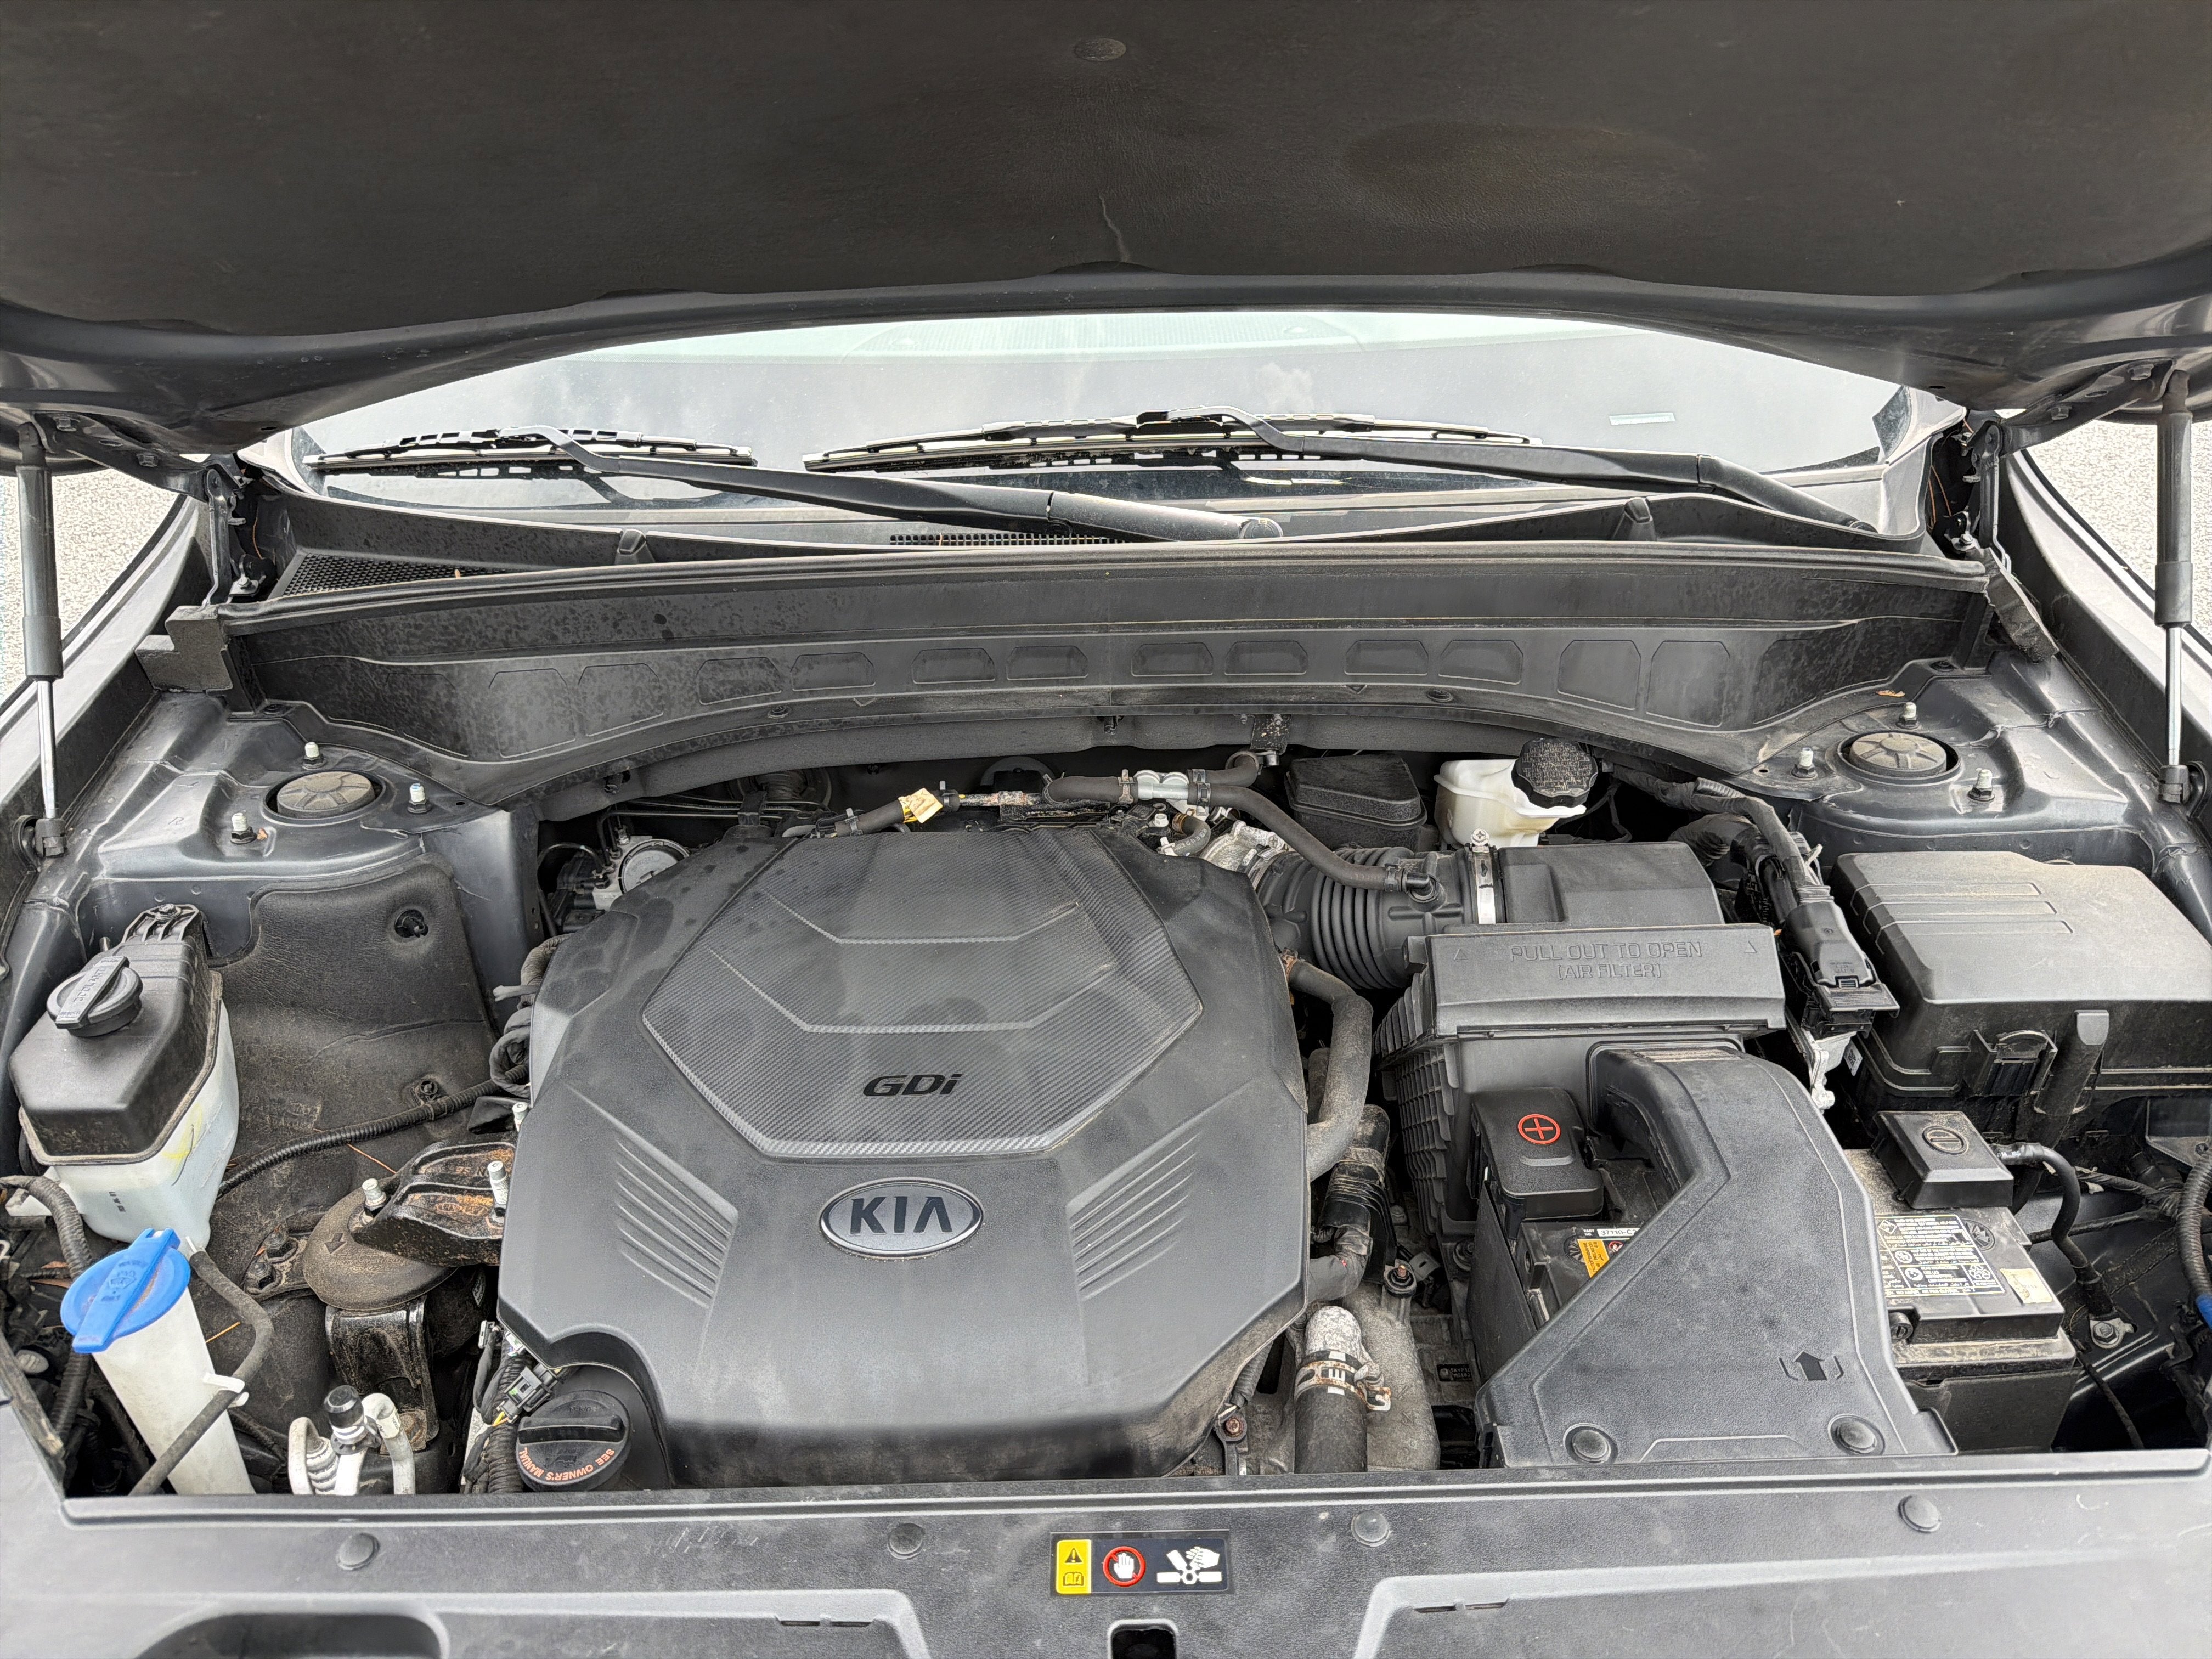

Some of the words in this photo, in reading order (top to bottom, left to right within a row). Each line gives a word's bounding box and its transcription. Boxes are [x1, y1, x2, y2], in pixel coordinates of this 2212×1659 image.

[1510, 945, 1562, 961] PULL
[1567, 943, 1608, 960] OUT
[1613, 943, 1641, 958] TO
[1647, 941, 1702, 958] OPEN
[863, 1074, 962, 1097] GDi
[850, 1196, 953, 1235] KIA
[518, 1447, 545, 1477] MANUAL
[595, 1448, 615, 1466] SEE
[545, 1464, 594, 1481] OWNER'S
